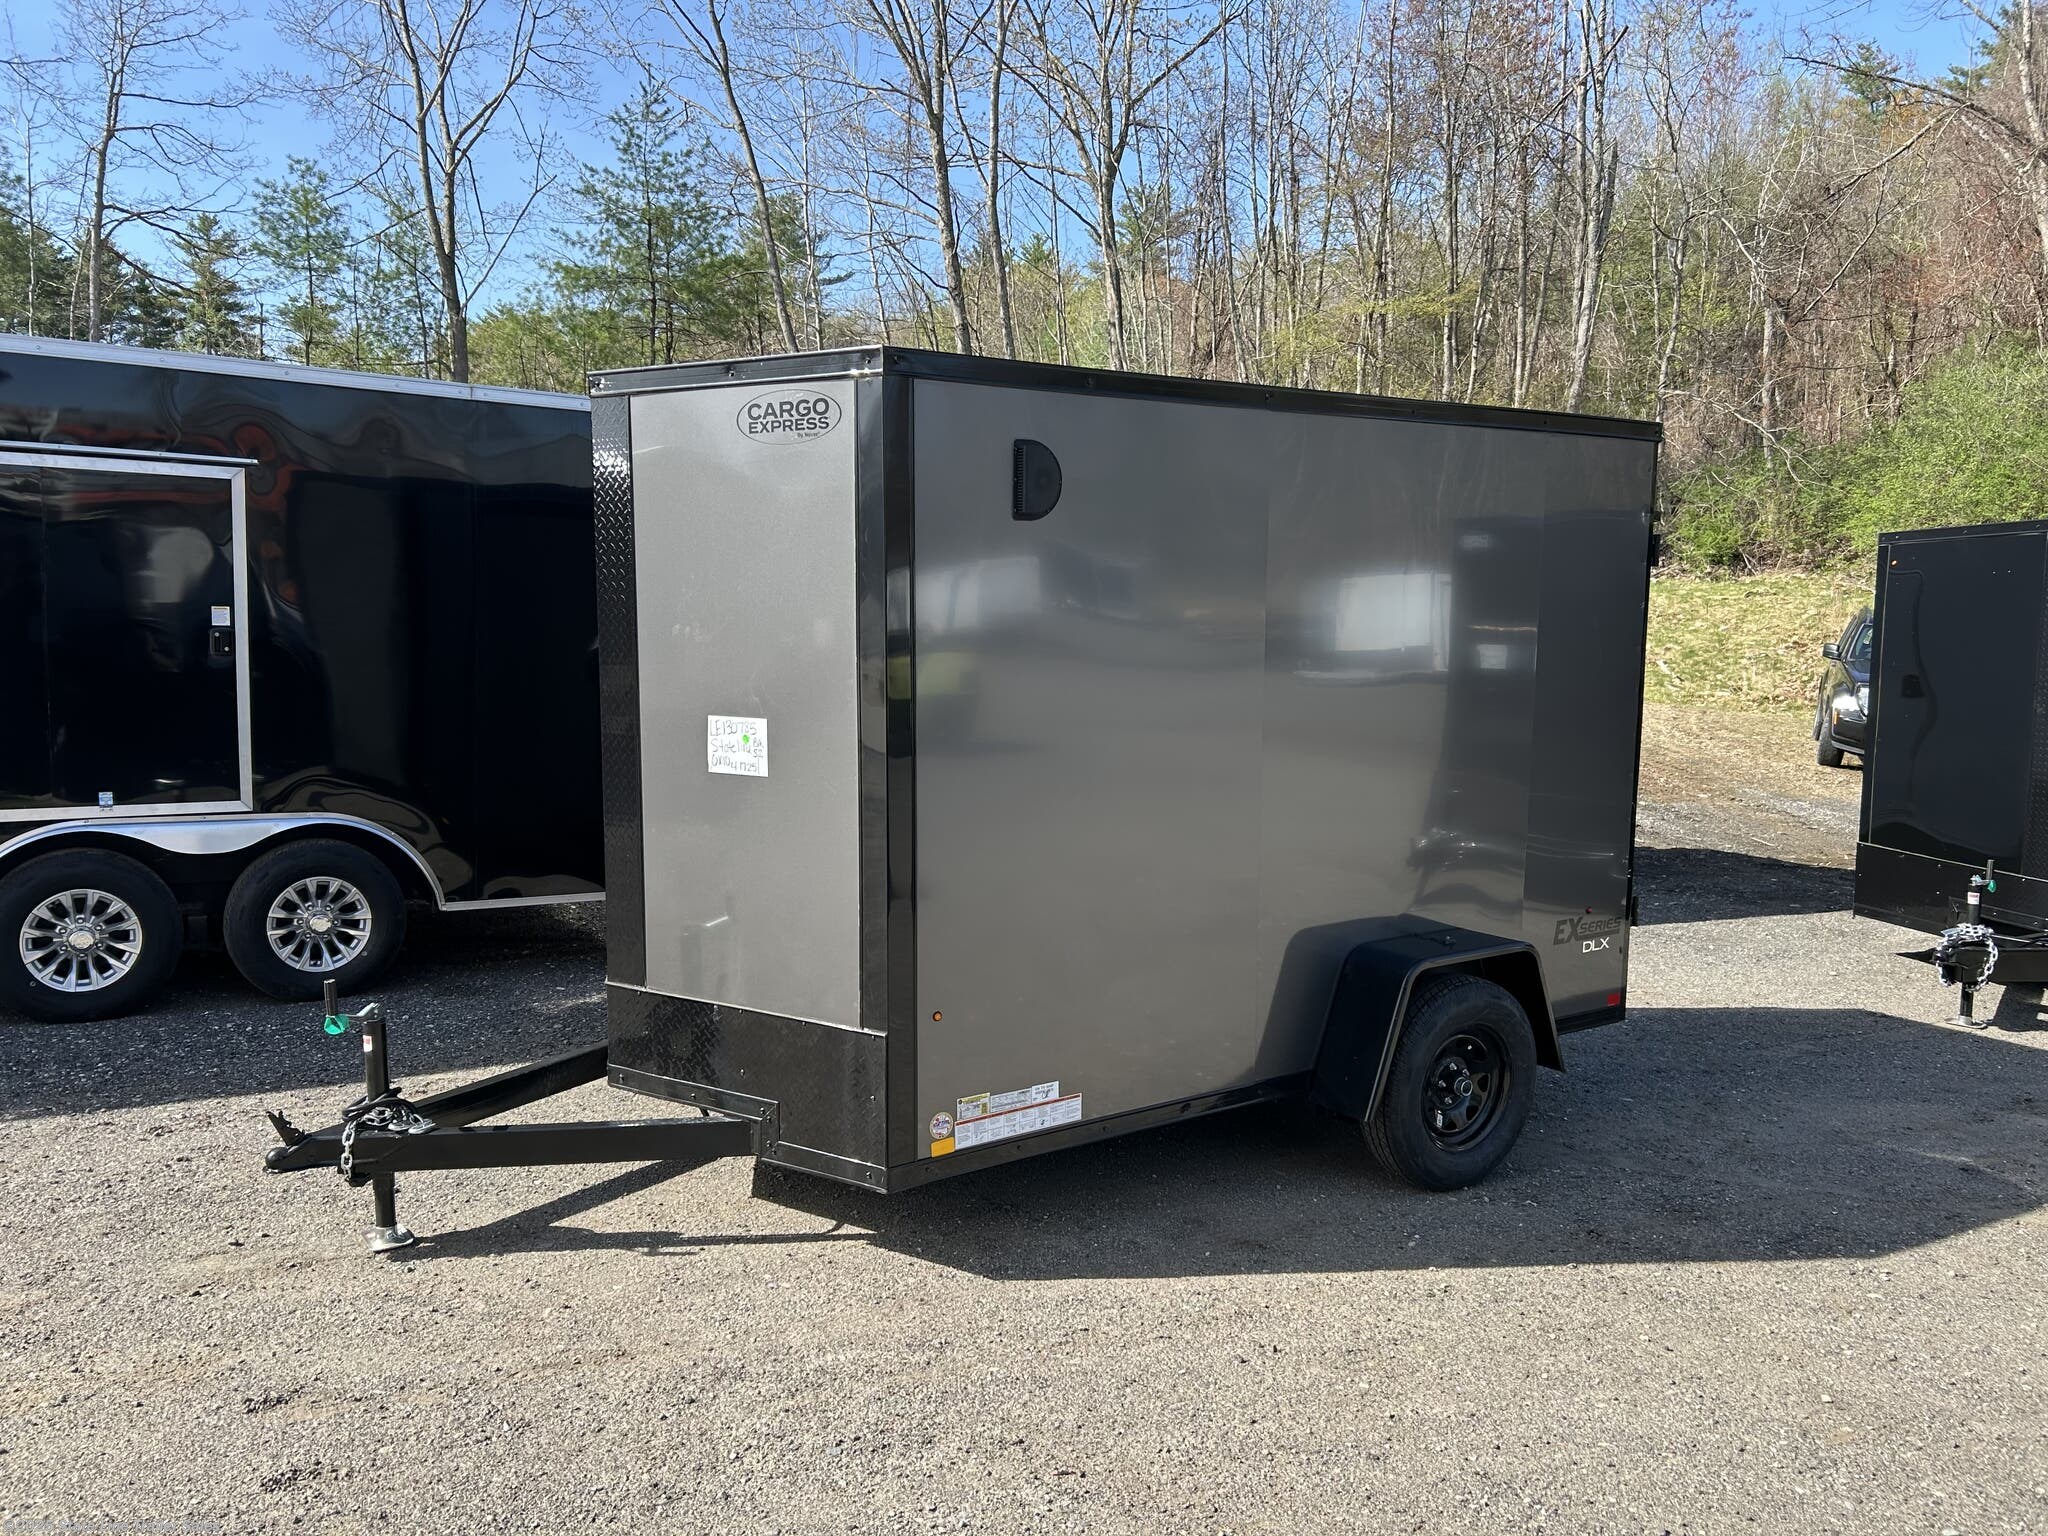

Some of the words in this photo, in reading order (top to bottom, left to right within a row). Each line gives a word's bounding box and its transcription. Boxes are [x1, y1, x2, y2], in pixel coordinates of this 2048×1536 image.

[747, 398, 830, 420] CARGO
[748, 416, 830, 434] EXPRESS
[1553, 916, 1583, 945] EX
[1578, 917, 1623, 934] SERIES
[1582, 937, 1610, 953] DLX
